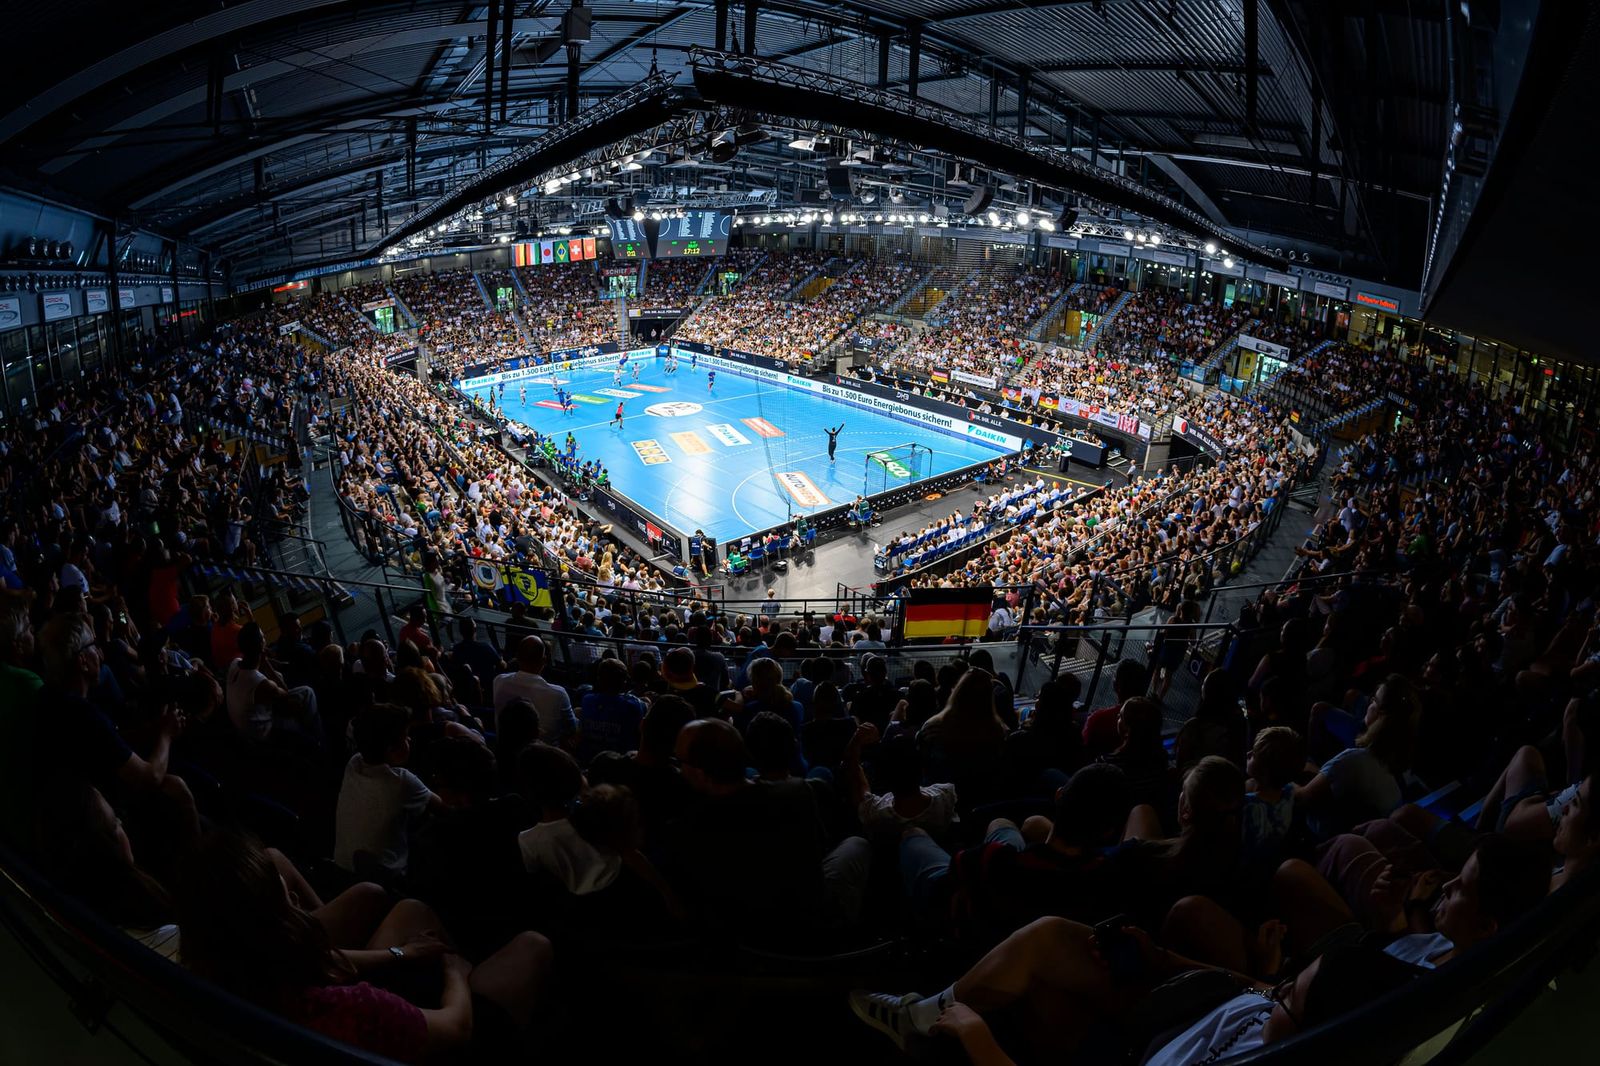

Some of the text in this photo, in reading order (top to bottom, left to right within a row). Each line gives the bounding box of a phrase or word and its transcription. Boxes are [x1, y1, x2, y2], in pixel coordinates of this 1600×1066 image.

[501, 372, 512, 380] Bis
[521, 367, 539, 376] 1.500
[598, 354, 620, 363] sichern!
[471, 376, 495, 386] DAIKIN
[792, 378, 812, 387] DAIKIN
[822, 385, 953, 428] Bis zu 1.500 Euro Energiebonus sichern!
[975, 429, 1007, 444] DAIKIN
